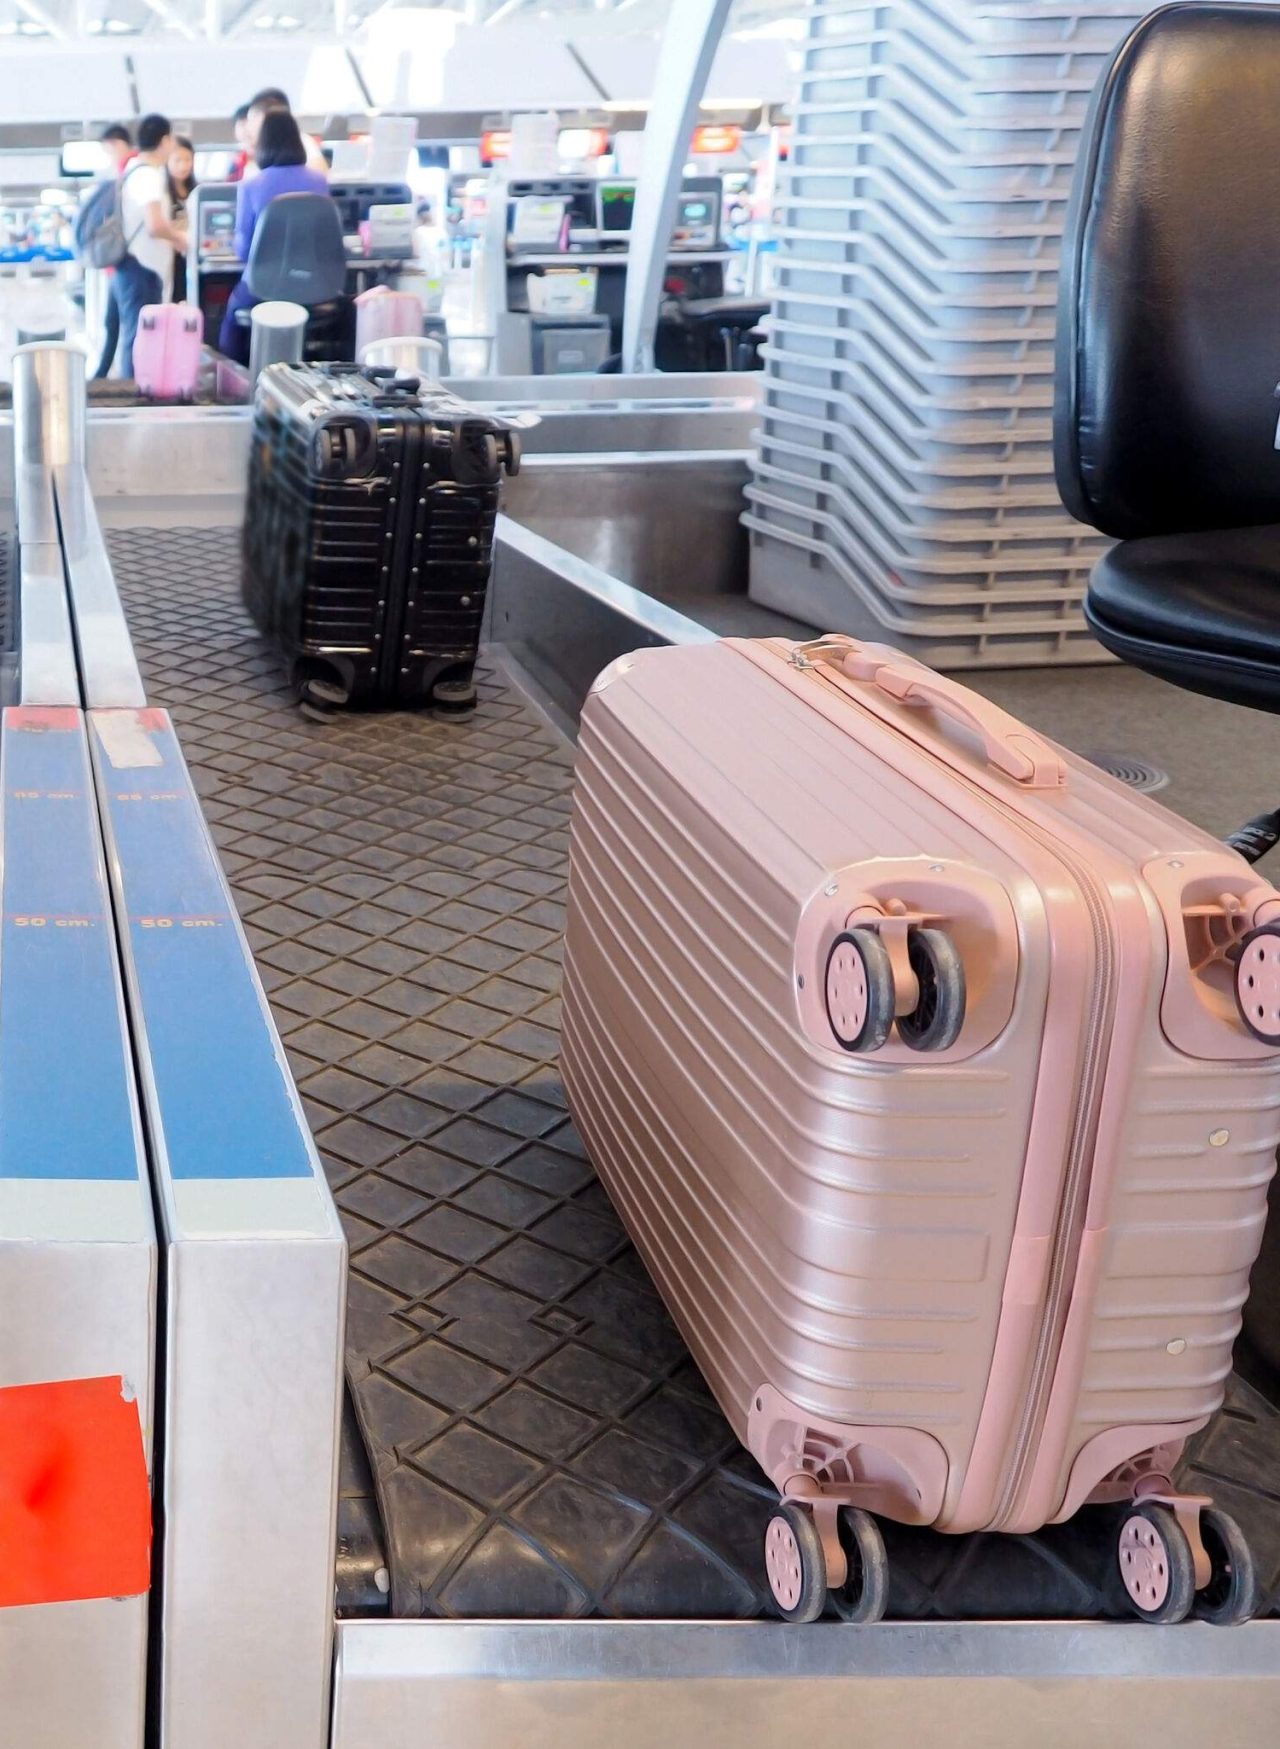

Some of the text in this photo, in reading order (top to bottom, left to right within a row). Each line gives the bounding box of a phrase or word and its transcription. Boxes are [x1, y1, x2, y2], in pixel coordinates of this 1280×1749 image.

[14, 917, 95, 928] 50 cm.
[140, 919, 223, 929] 50 cm.
